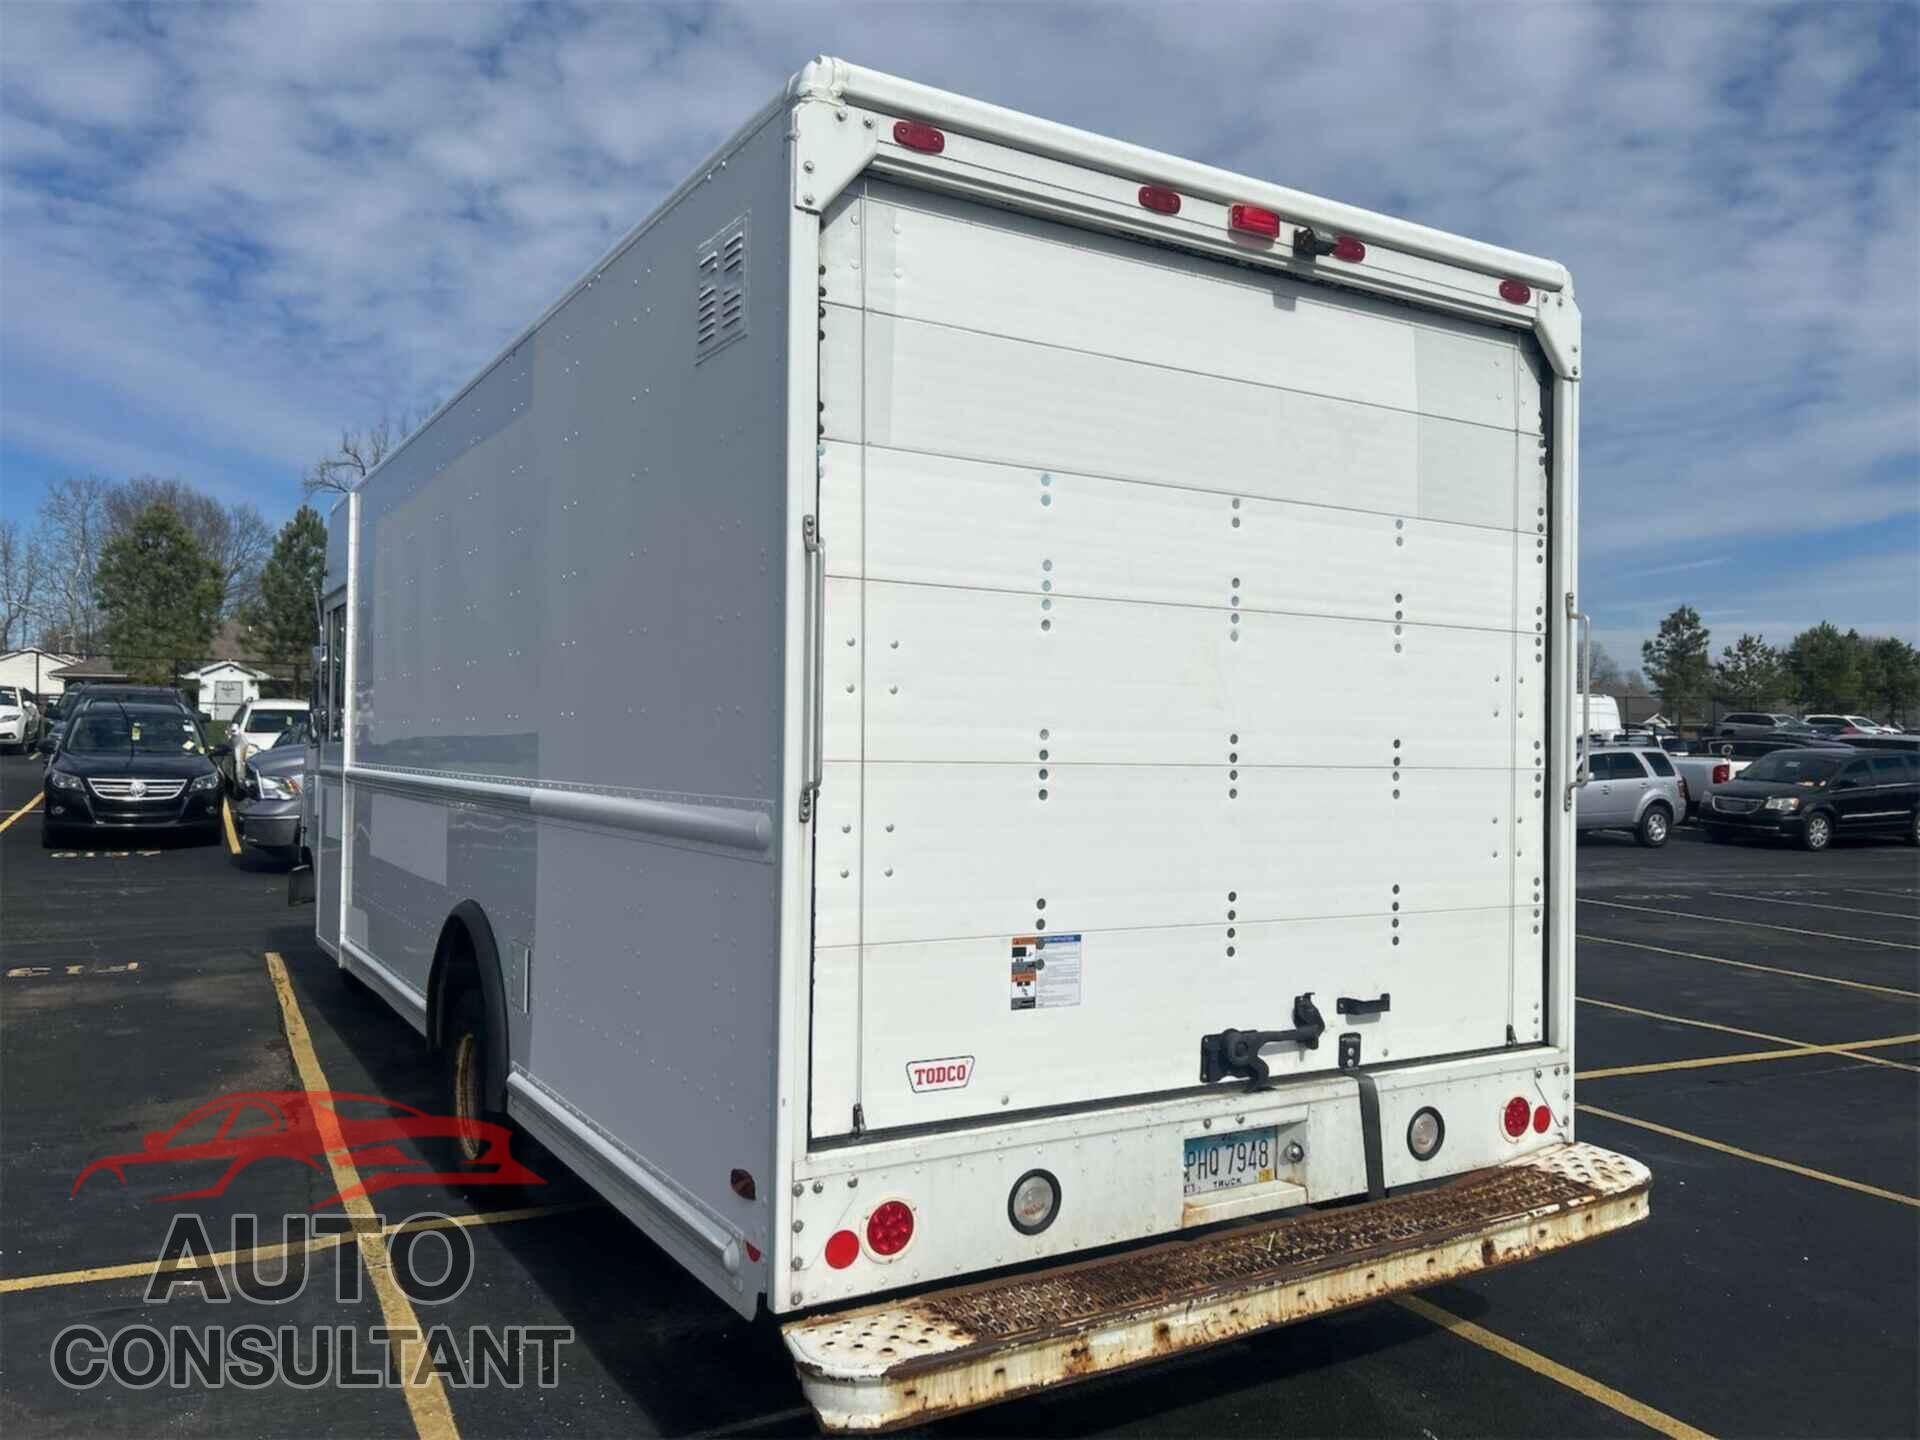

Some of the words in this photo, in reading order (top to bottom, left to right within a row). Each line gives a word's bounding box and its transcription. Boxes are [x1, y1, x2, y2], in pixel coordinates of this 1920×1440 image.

[914, 1064, 967, 1086] TODCO
[1226, 1138, 1269, 1175] 7948
[1213, 1177, 1242, 1188] TRUCK
